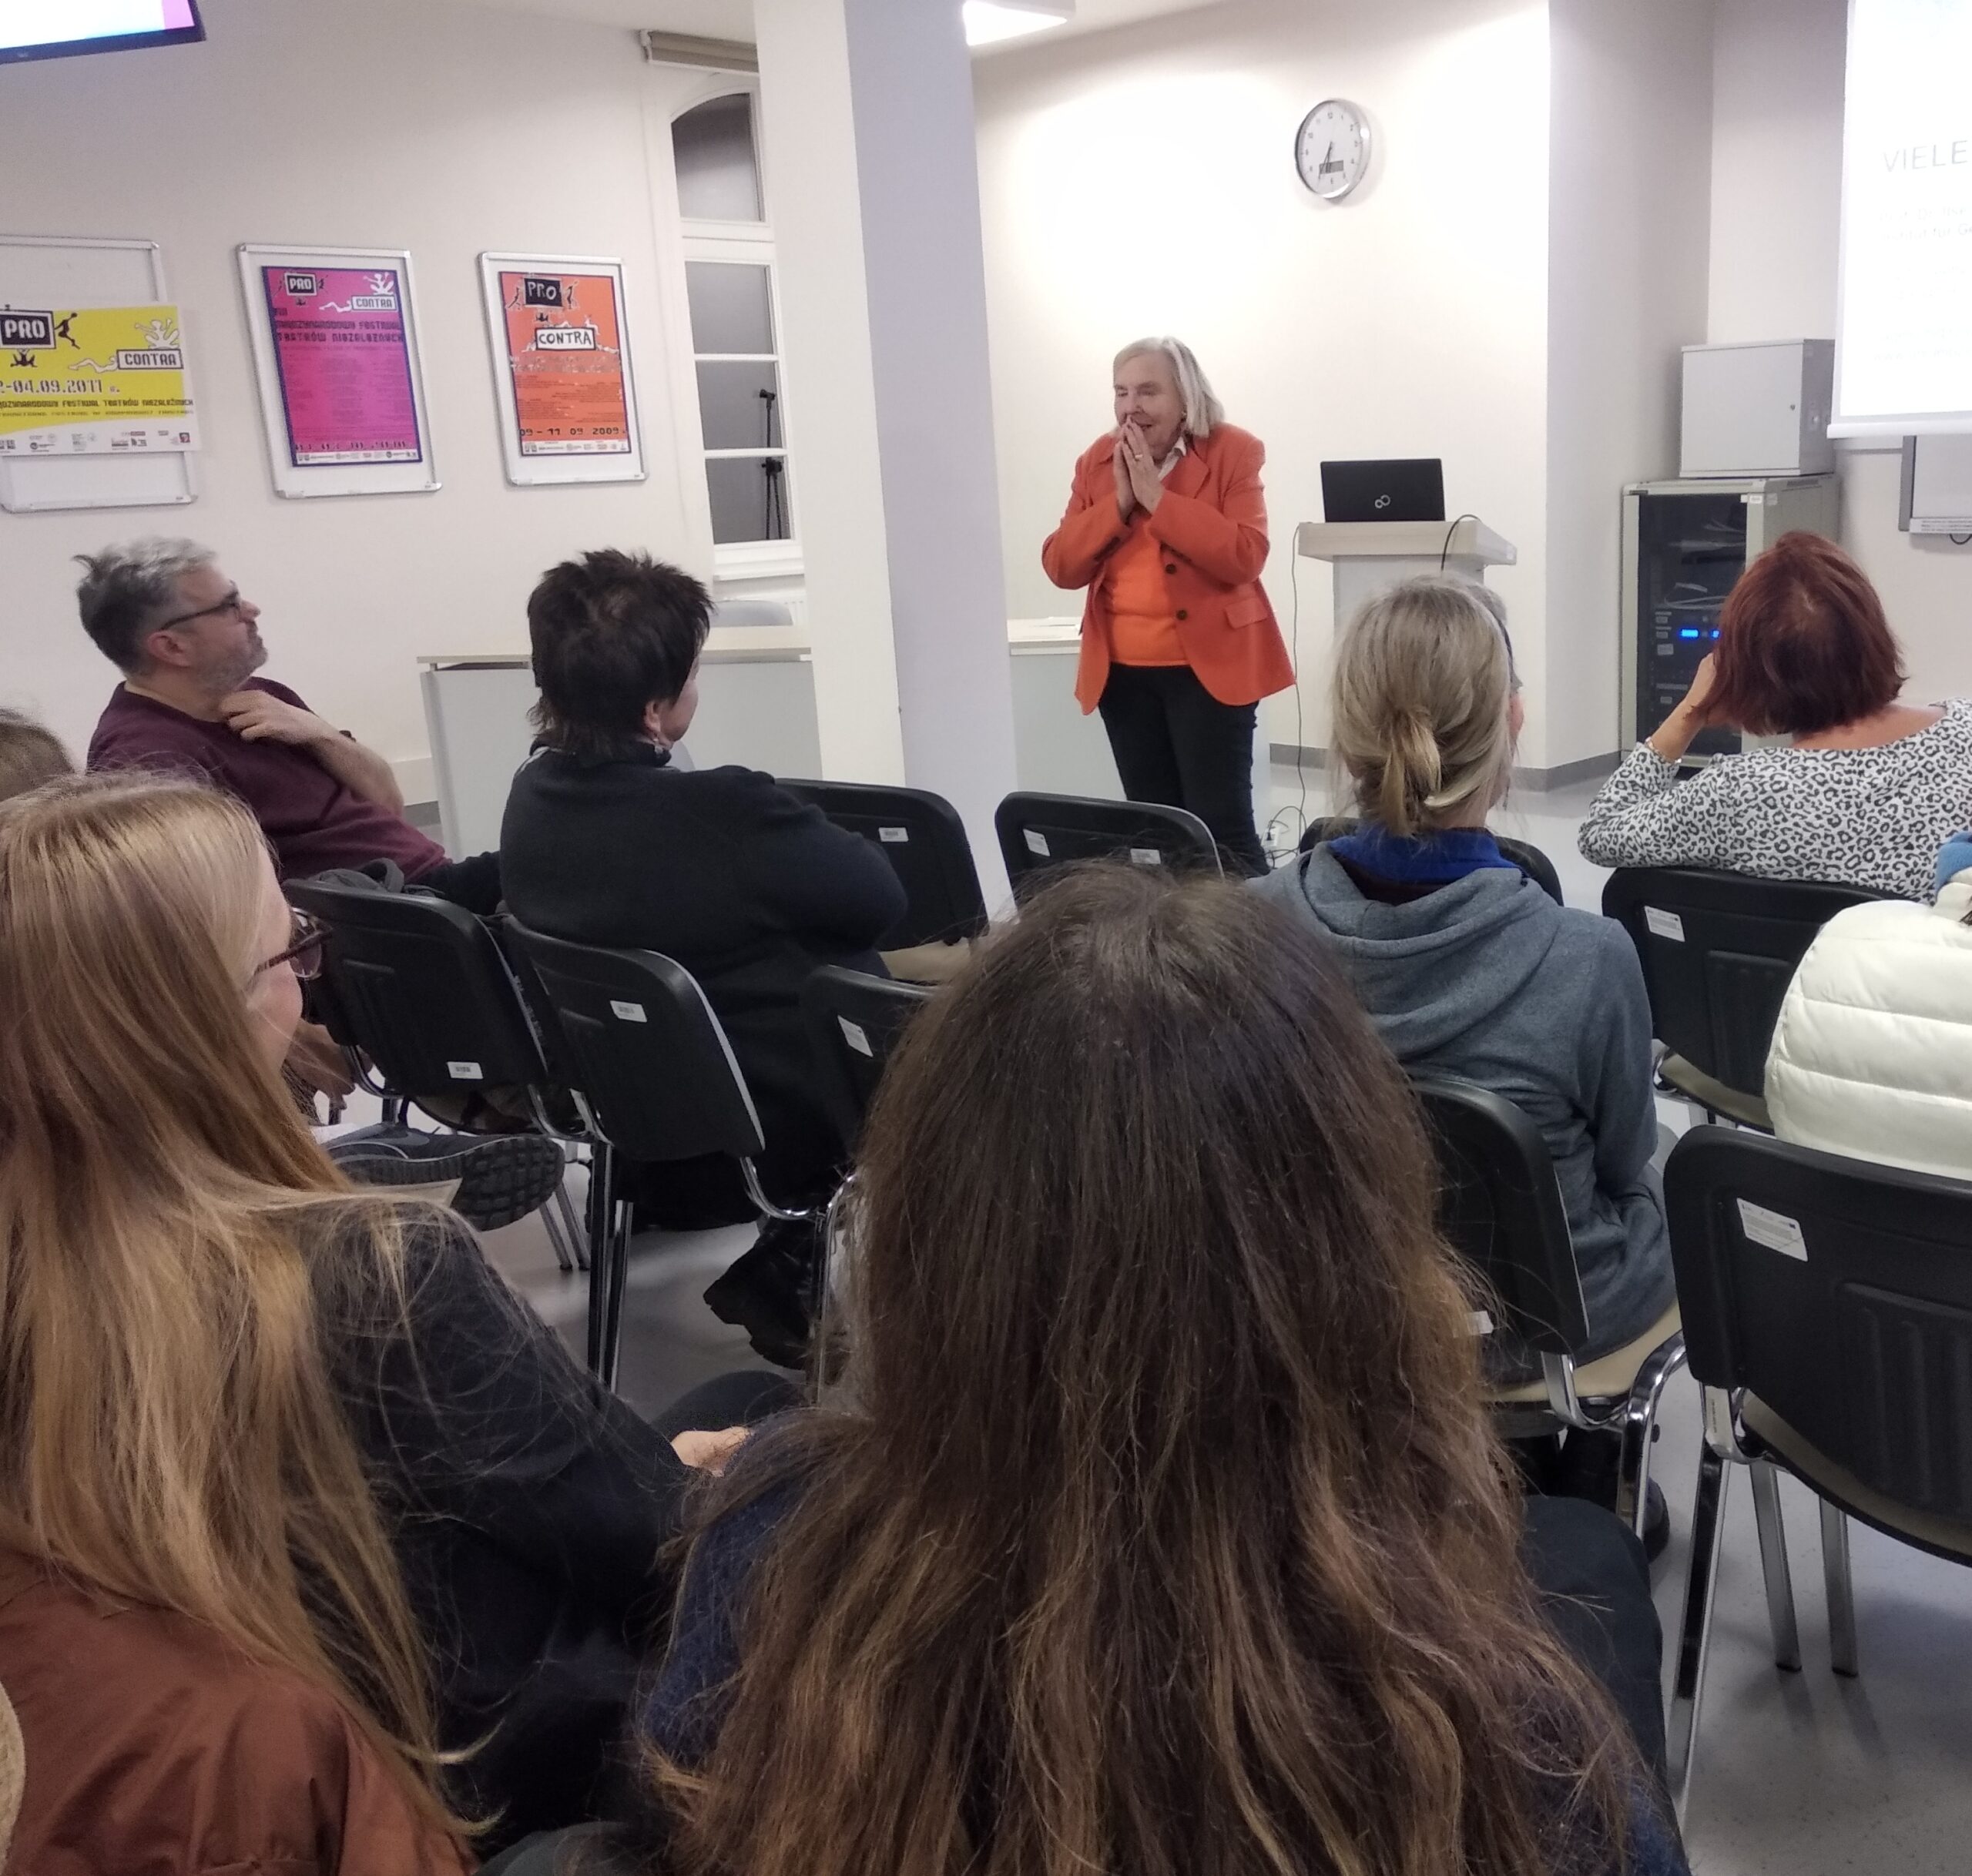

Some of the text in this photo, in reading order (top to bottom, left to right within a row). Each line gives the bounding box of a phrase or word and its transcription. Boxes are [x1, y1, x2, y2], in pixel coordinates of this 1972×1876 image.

[1883, 140, 1967, 173] VIELE
[290, 277, 313, 290] PRO
[526, 281, 557, 300] PRO
[355, 297, 393, 308] CONTRA
[5, 319, 46, 339] PRO
[538, 331, 592, 345] CONTRA
[124, 352, 177, 366] CONTRA
[547, 427, 561, 436] 11
[570, 427, 584, 436] 09
